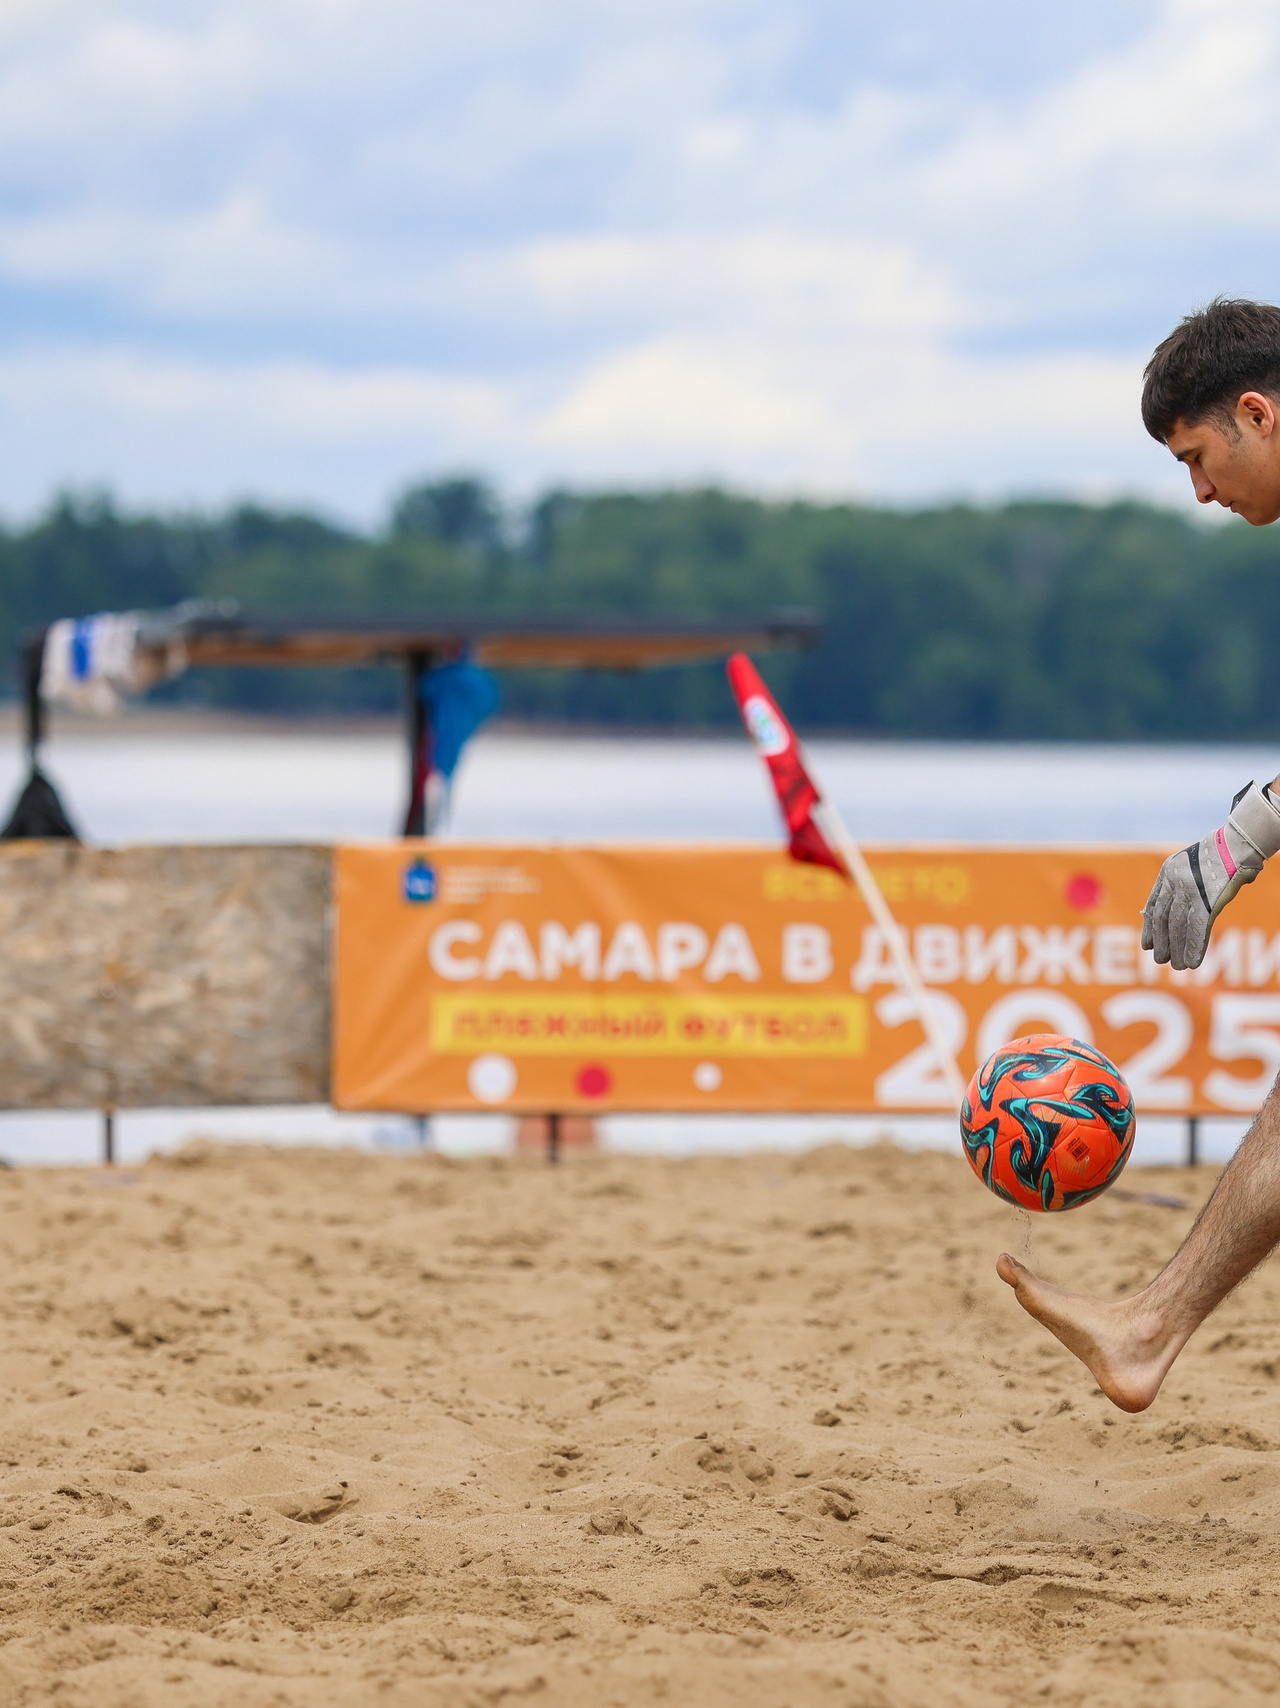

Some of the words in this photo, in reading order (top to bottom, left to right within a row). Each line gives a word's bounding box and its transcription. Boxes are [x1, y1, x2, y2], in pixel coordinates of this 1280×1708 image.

[428, 920, 761, 982] САМАРА
[781, 922, 835, 983] В
[682, 1010, 848, 1040] ФУТБОЛ
